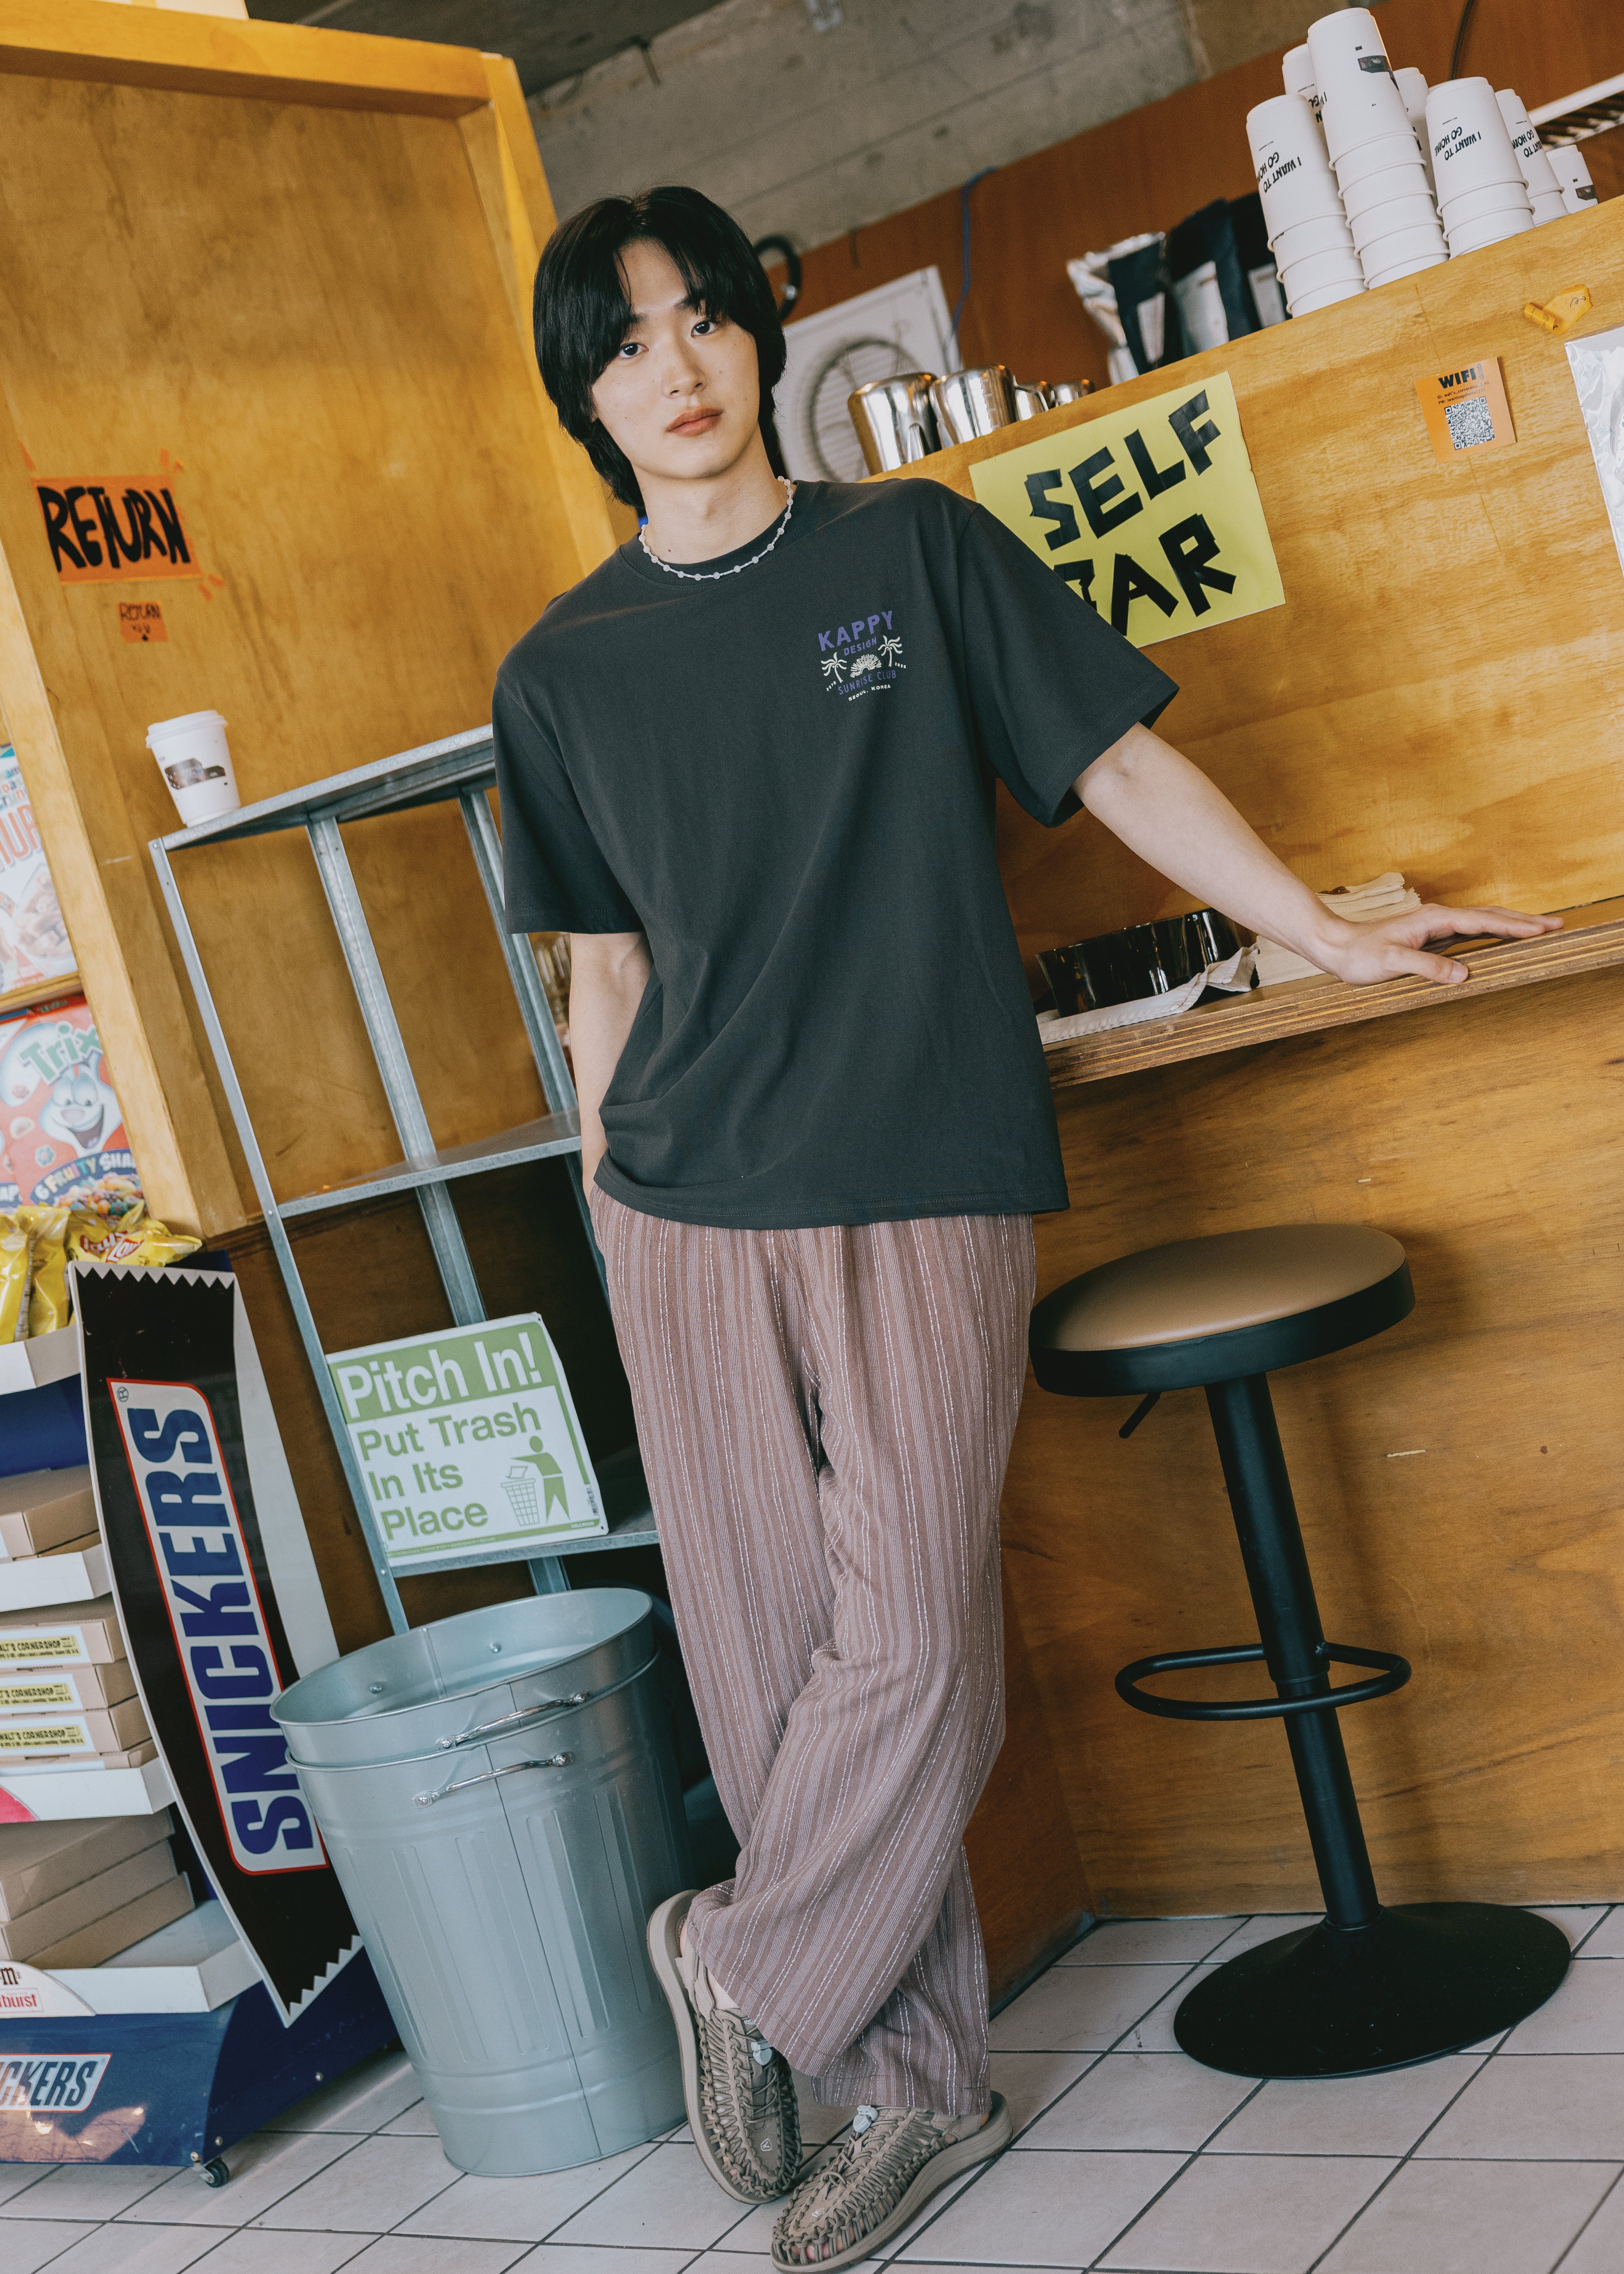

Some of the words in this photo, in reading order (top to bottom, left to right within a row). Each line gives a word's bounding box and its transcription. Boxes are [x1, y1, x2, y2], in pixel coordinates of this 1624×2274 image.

[1435, 134, 1450, 157] HOME
[1451, 126, 1462, 140] GO
[1455, 134, 1477, 153] WANT
[1512, 134, 1527, 149] HOM
[1526, 129, 1534, 140] GO
[1268, 152, 1279, 168] GO
[1445, 148, 1454, 161] TO
[1524, 146, 1534, 158] TO
[1273, 159, 1297, 184] WANT
[1264, 178, 1272, 193] TO
[1024, 389, 1221, 551] SELF
[36, 486, 191, 572] RETURN
[818, 611, 893, 652] KAPPY
[844, 637, 877, 656] DESIGN
[838, 674, 873, 695] SUNRISE
[877, 670, 897, 680] CLUB
[20, 1025, 101, 1080] Trix
[44, 1157, 97, 1193] FRUITY
[337, 1349, 470, 1419] Pitch
[474, 1332, 542, 1392] In!
[357, 1422, 424, 1461] Put
[429, 1402, 541, 1446] Trash
[369, 1471, 405, 1501] In
[413, 1462, 463, 1494] Its
[381, 1502, 488, 1540] Place
[127, 1408, 314, 1854] SNICKERS
[0, 1994, 37, 2007] burst
